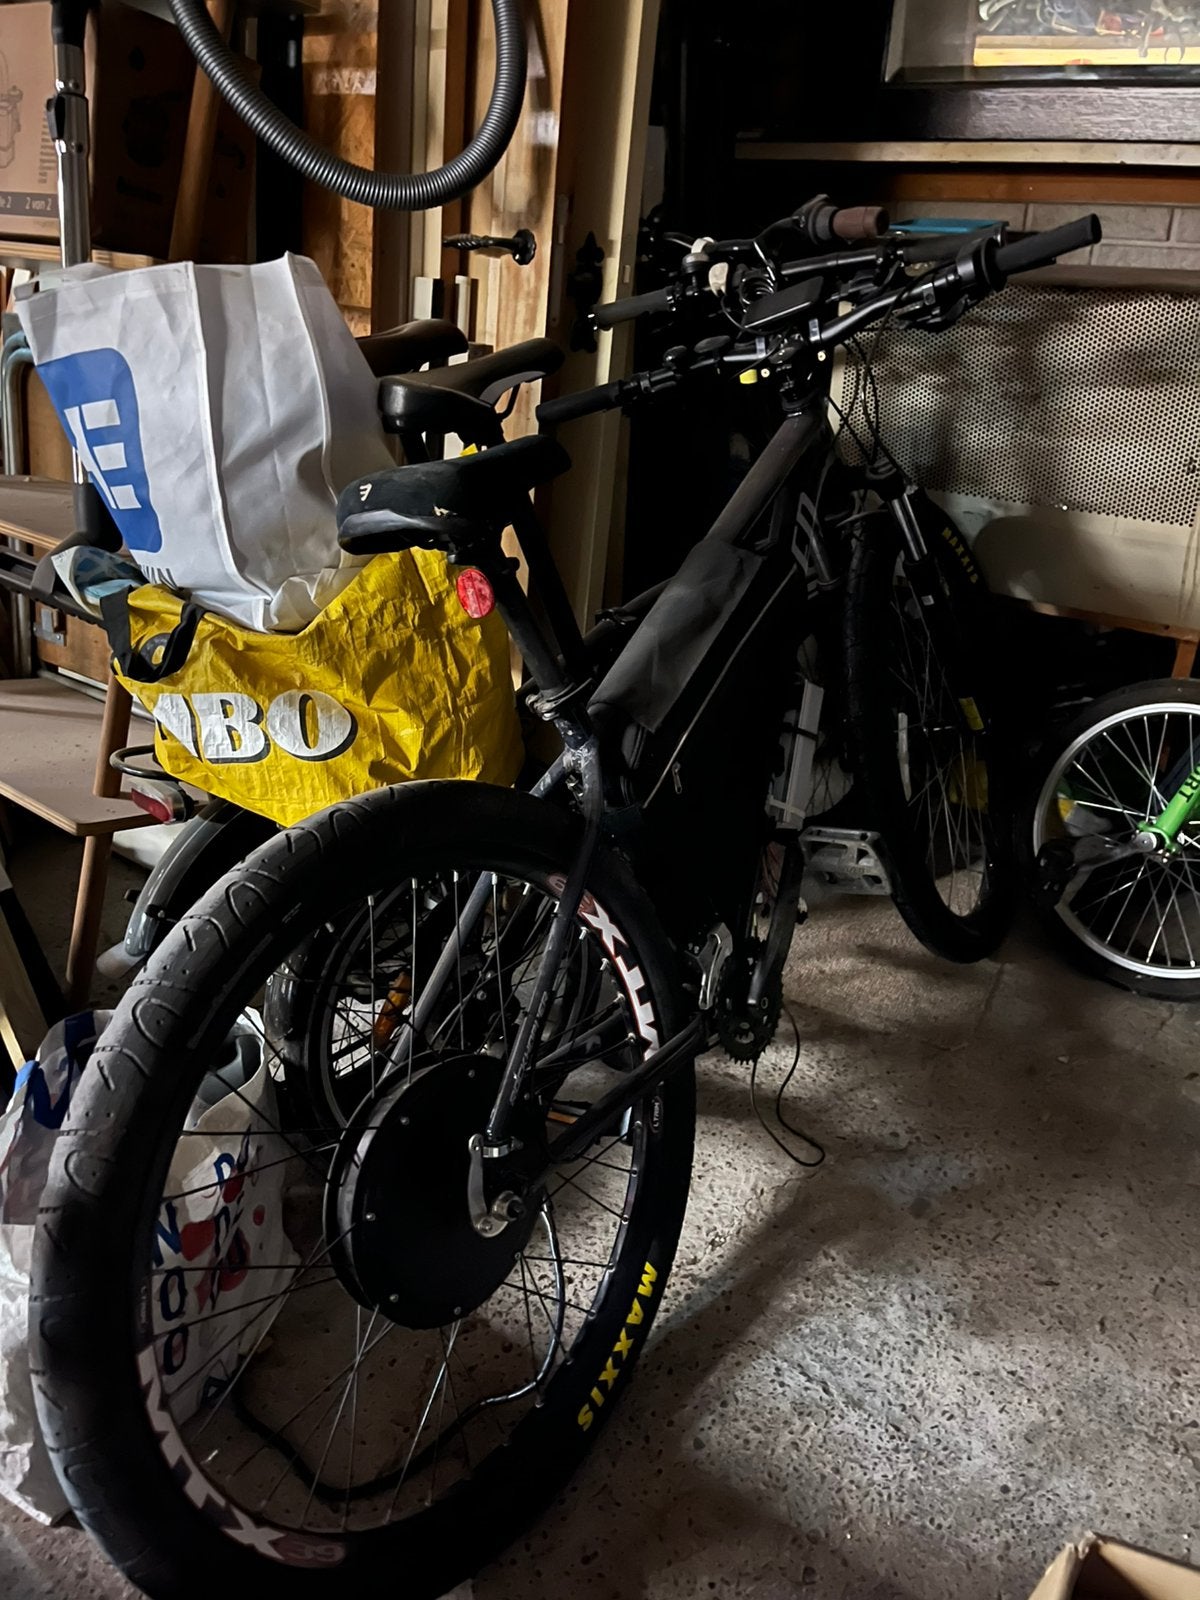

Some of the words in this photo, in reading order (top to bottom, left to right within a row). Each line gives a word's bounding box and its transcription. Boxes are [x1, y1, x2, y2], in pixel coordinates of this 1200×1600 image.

[25, 196, 31, 210] 2
[32, 200, 46, 210] von
[940, 526, 979, 584] MAXXIS
[576, 1260, 659, 1432] MAXXIS
[135, 1344, 286, 1560] MTX
